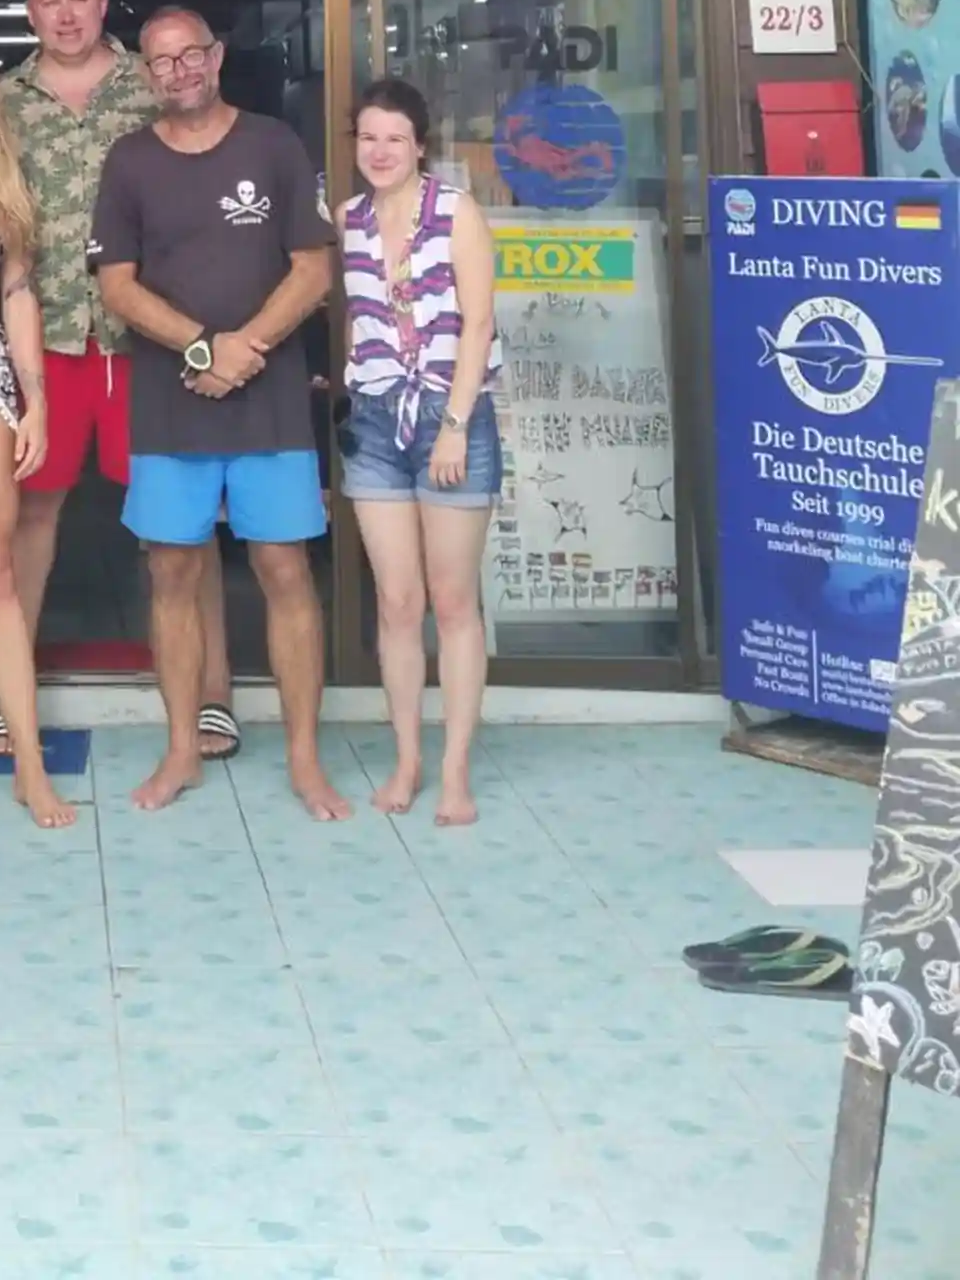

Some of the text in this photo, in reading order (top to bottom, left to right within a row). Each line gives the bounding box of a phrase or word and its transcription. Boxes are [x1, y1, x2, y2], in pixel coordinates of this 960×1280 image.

[760, 5, 824, 36] 22/3
[772, 198, 886, 227] DIVING
[496, 242, 604, 278] ROX
[729, 252, 942, 285] Lanta Fun Divers
[794, 299, 860, 327] LANTA
[752, 421, 924, 464] Die Deutsche
[753, 452, 924, 498] Tauchschule
[792, 489, 885, 526] Seit 1999
